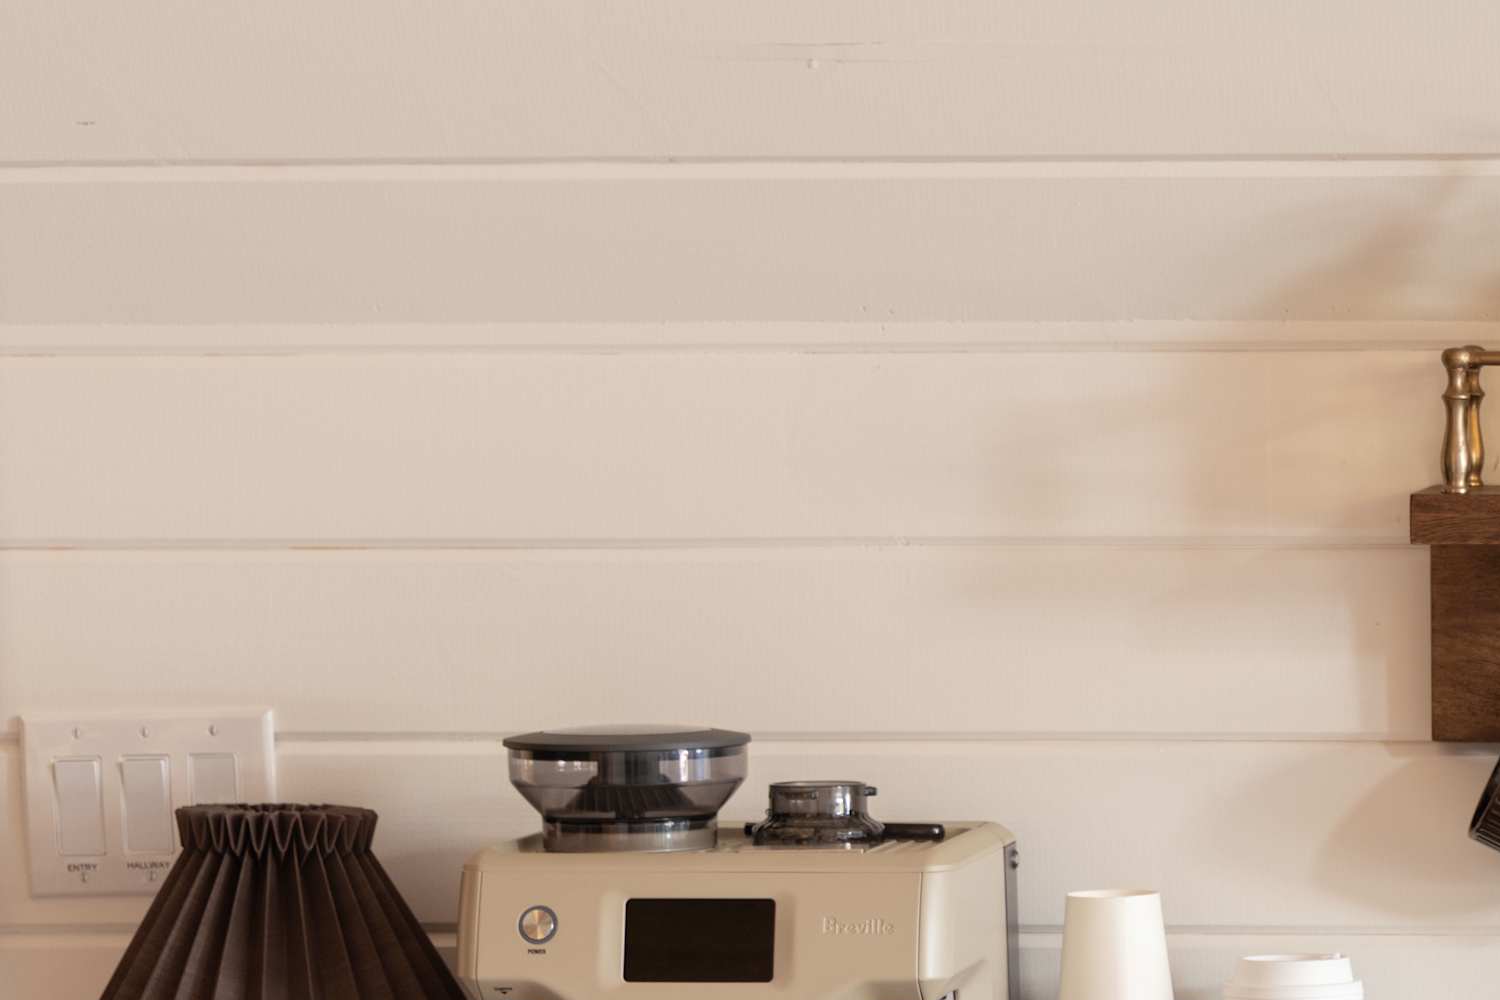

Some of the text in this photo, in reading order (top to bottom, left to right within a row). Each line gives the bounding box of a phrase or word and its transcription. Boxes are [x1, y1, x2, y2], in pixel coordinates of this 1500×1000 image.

[67, 864, 97, 872] ENTRY
[127, 861, 170, 870] HALLWAY
[821, 916, 896, 935] Breville
